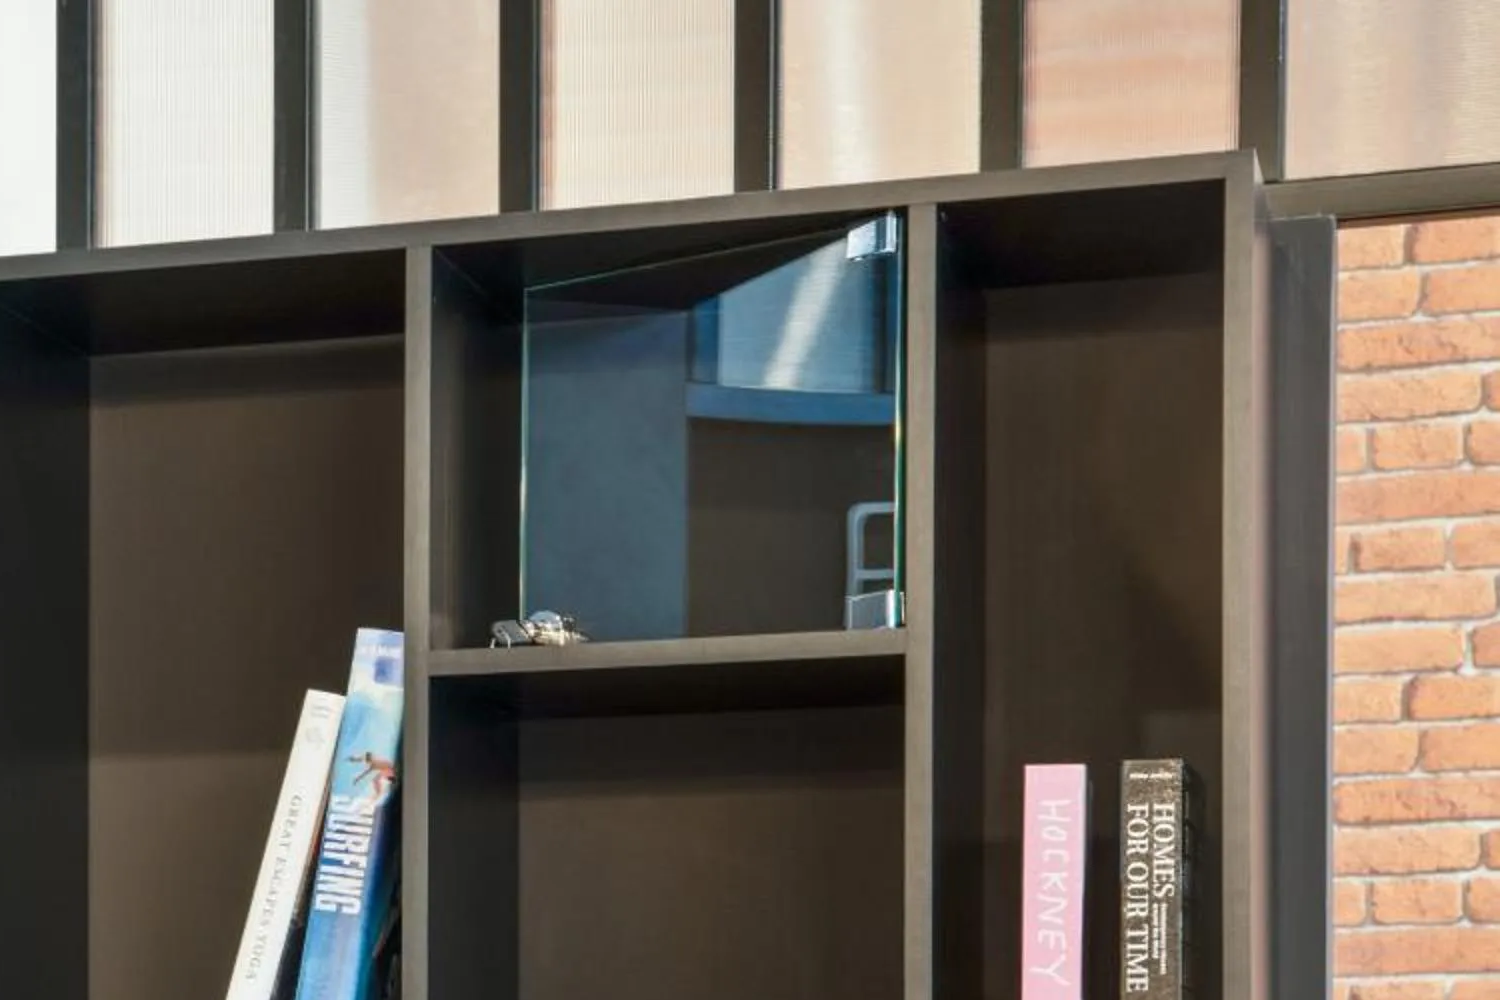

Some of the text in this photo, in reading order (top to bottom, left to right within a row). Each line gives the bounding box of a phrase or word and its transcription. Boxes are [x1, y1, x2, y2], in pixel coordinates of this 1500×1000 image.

[314, 795, 378, 917] SURFING
[1125, 803, 1150, 993] FOR OUR TIME
[1152, 801, 1177, 900] HOMES
